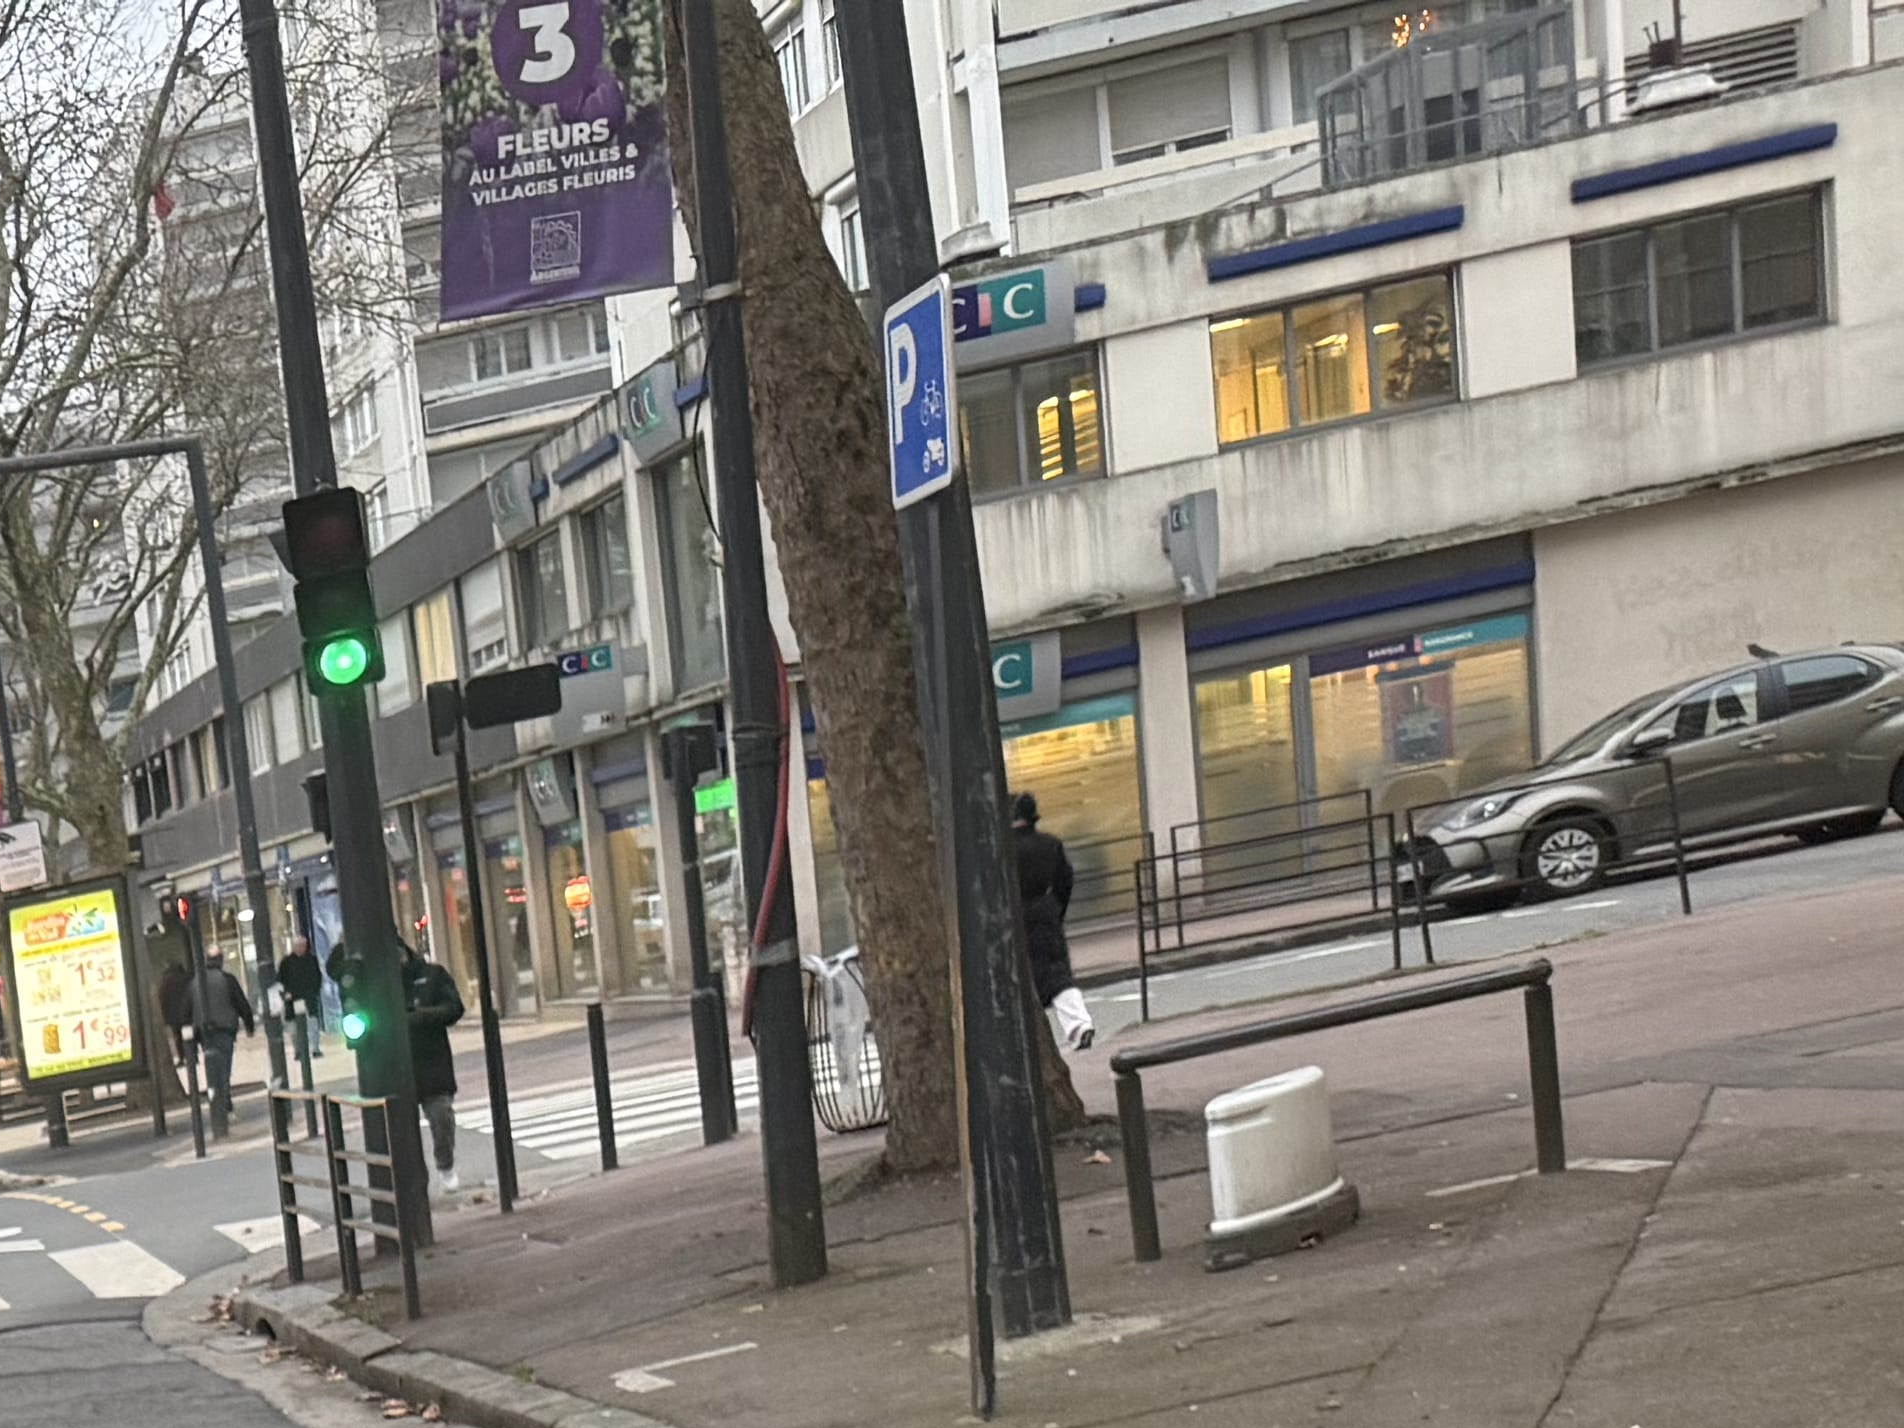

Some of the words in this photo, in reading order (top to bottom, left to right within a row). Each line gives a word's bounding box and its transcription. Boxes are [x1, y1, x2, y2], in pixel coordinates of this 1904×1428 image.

[518, 1, 576, 83] 3
[497, 118, 610, 160] FLEURS
[469, 167, 495, 187] AU
[499, 157, 557, 181] LABEL
[561, 148, 621, 170] VILLES
[625, 143, 638, 158] &
[472, 178, 559, 207] VILLAGES
[563, 164, 636, 191] FLEURIS
[890, 322, 917, 445] P
[561, 649, 608, 673] CIC
